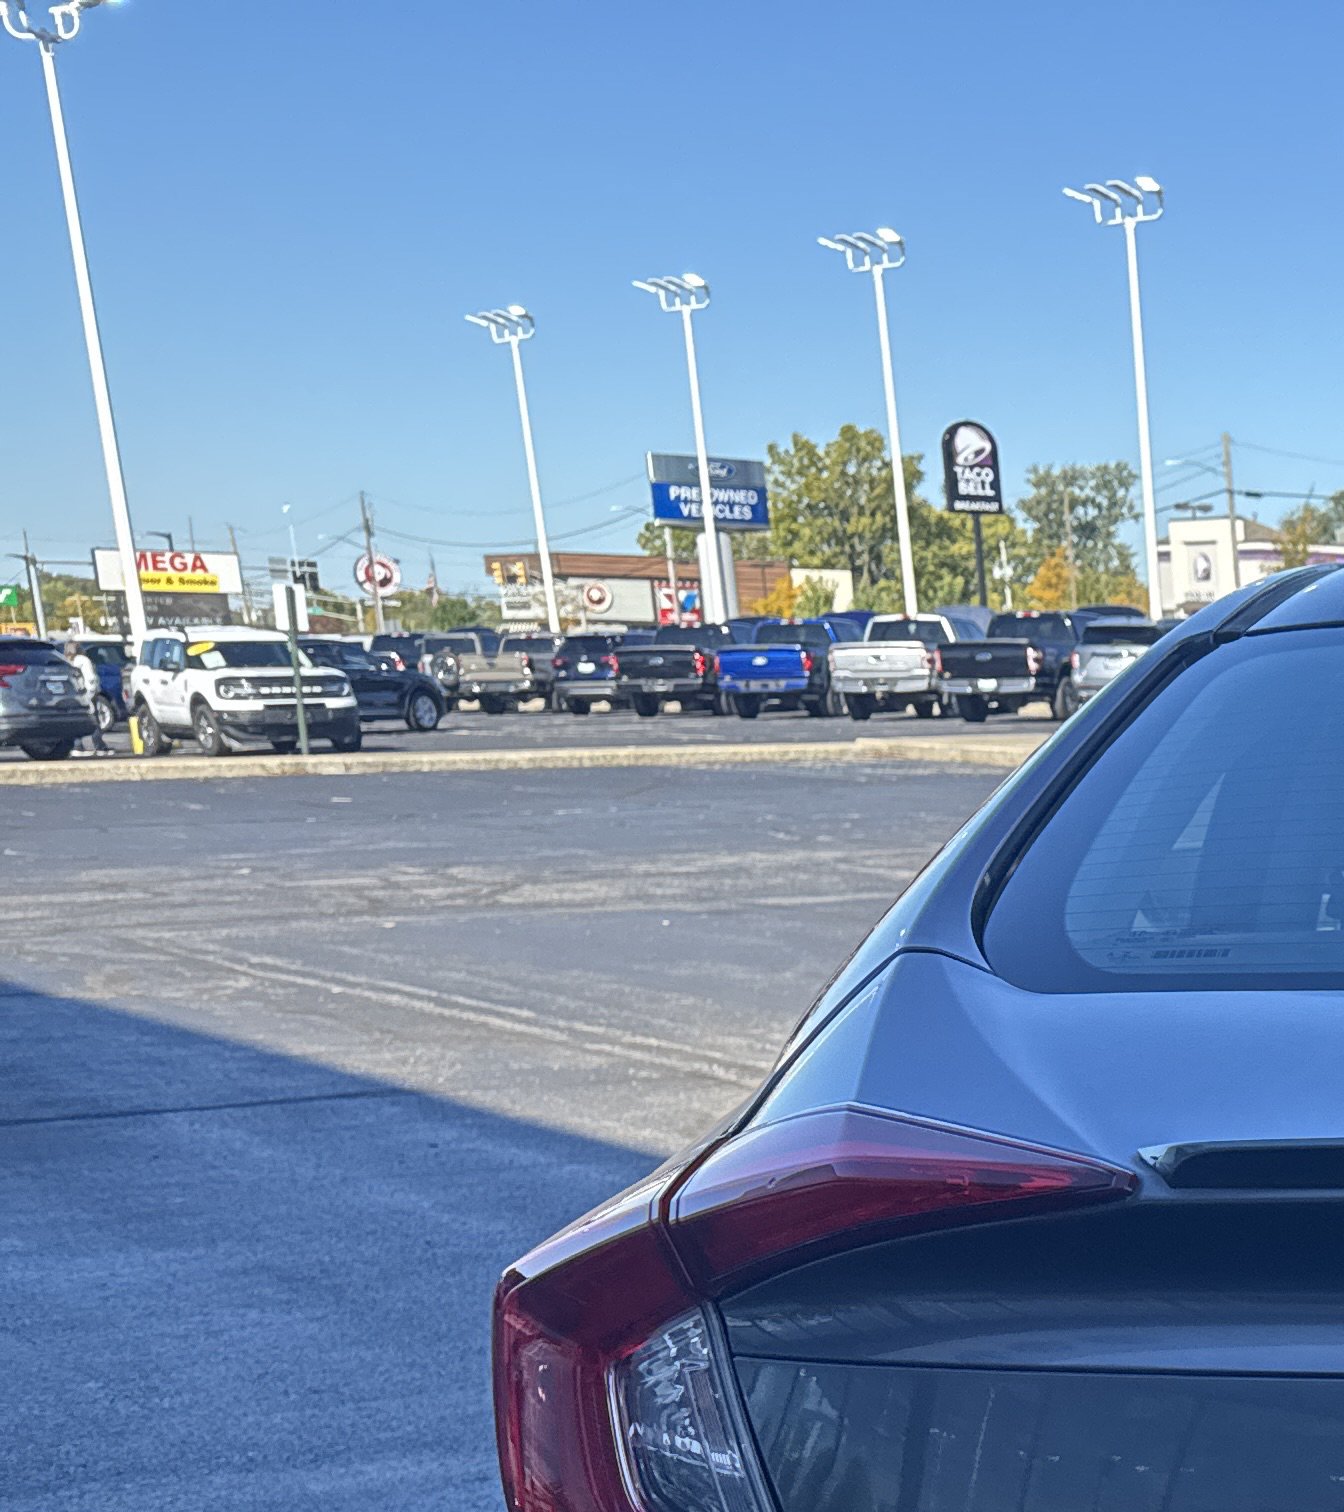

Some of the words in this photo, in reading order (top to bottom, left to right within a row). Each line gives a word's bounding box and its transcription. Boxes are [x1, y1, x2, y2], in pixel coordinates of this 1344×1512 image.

[953, 465, 994, 482] TACO
[669, 485, 758, 505] PREOWNED
[958, 480, 995, 496] BELL
[679, 502, 752, 520] VEICLES
